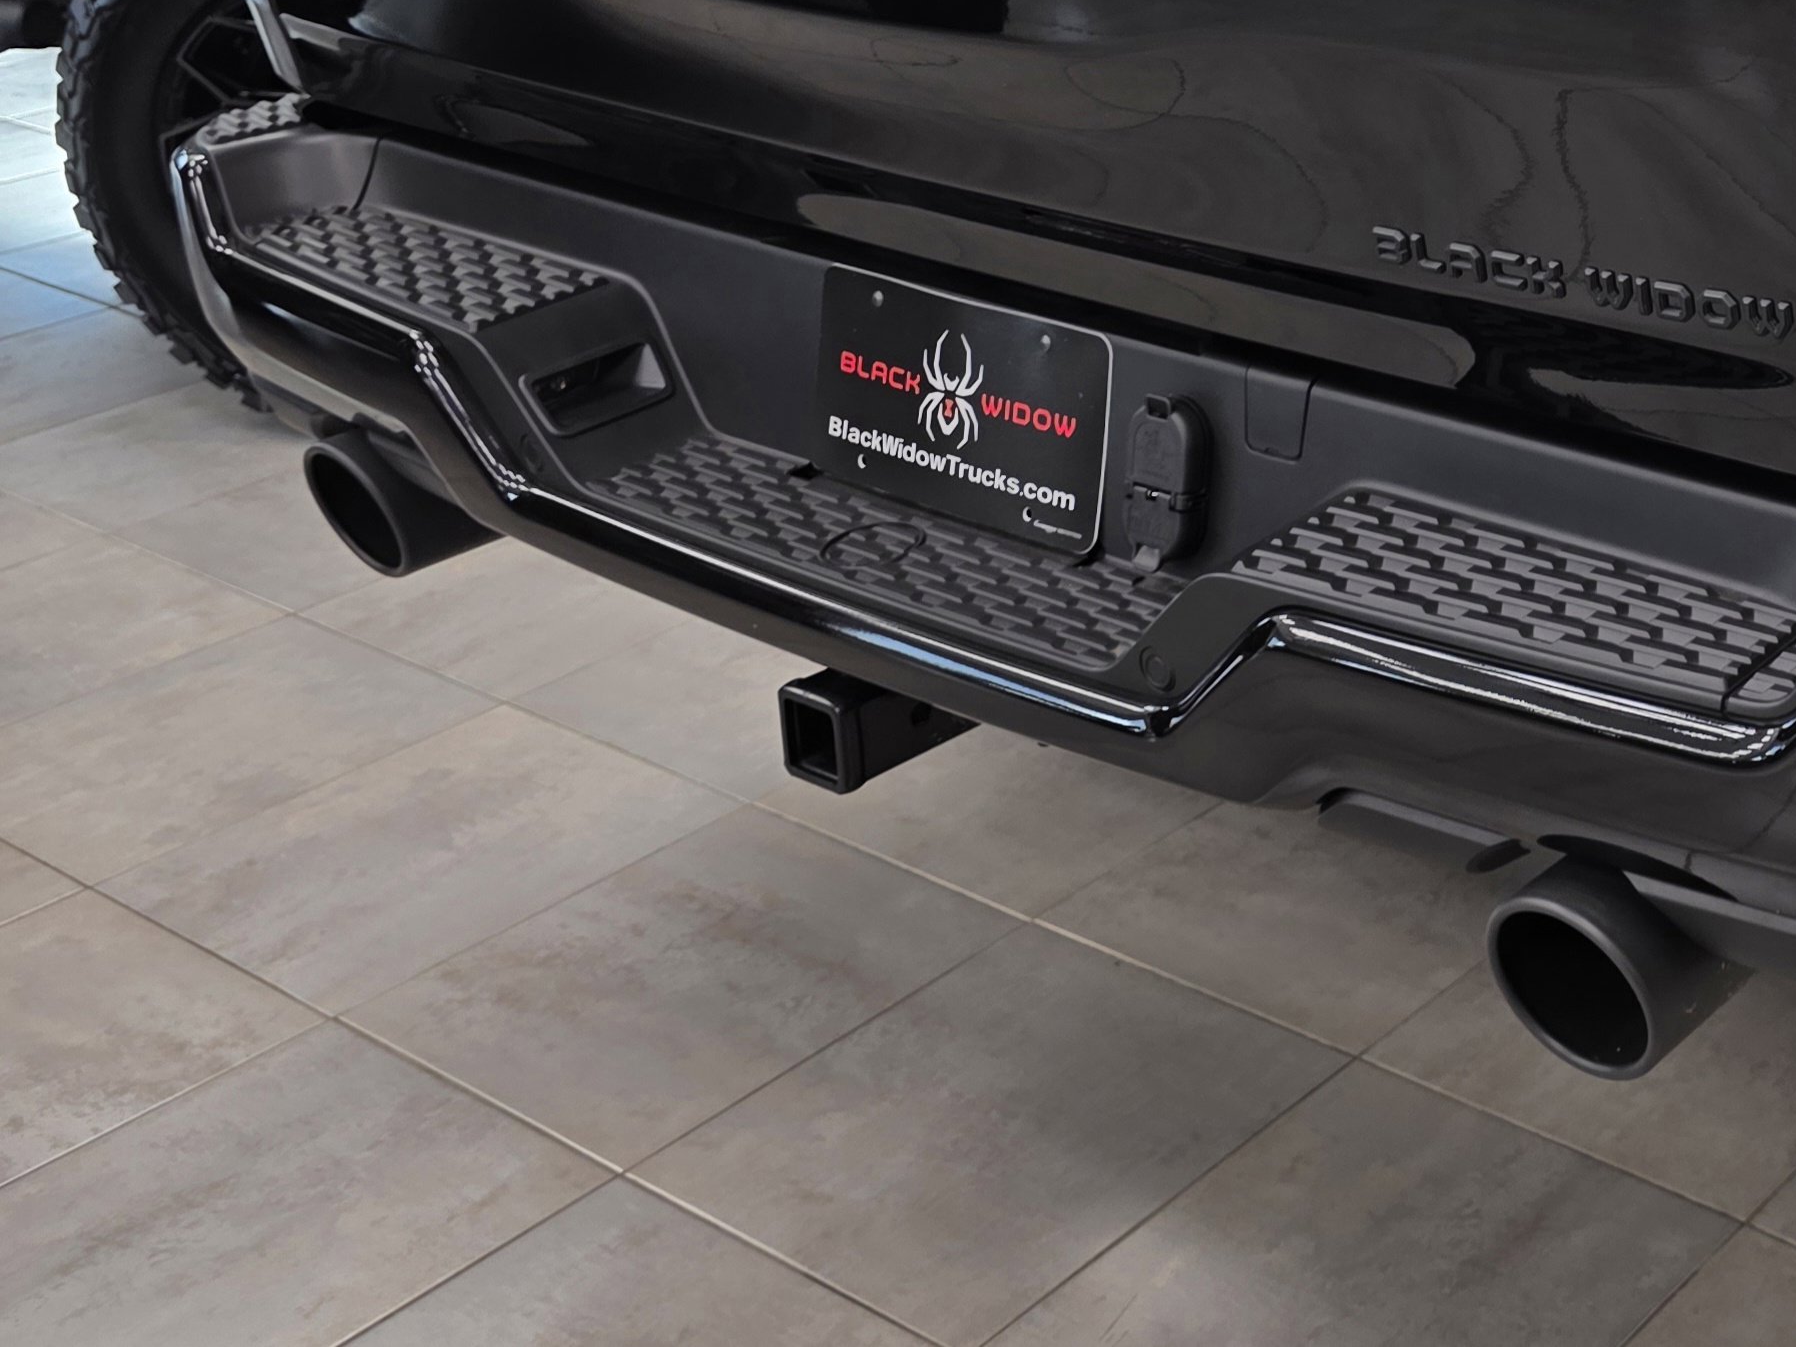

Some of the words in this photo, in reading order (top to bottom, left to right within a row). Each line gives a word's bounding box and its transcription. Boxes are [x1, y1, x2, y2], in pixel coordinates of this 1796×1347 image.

[1371, 225, 1567, 299] BLACK
[1584, 266, 1796, 339] WIDOW
[839, 350, 922, 395] BLACK
[981, 392, 1077, 439] WIDOW
[828, 415, 1076, 511] BlackWidowTrucks.com
